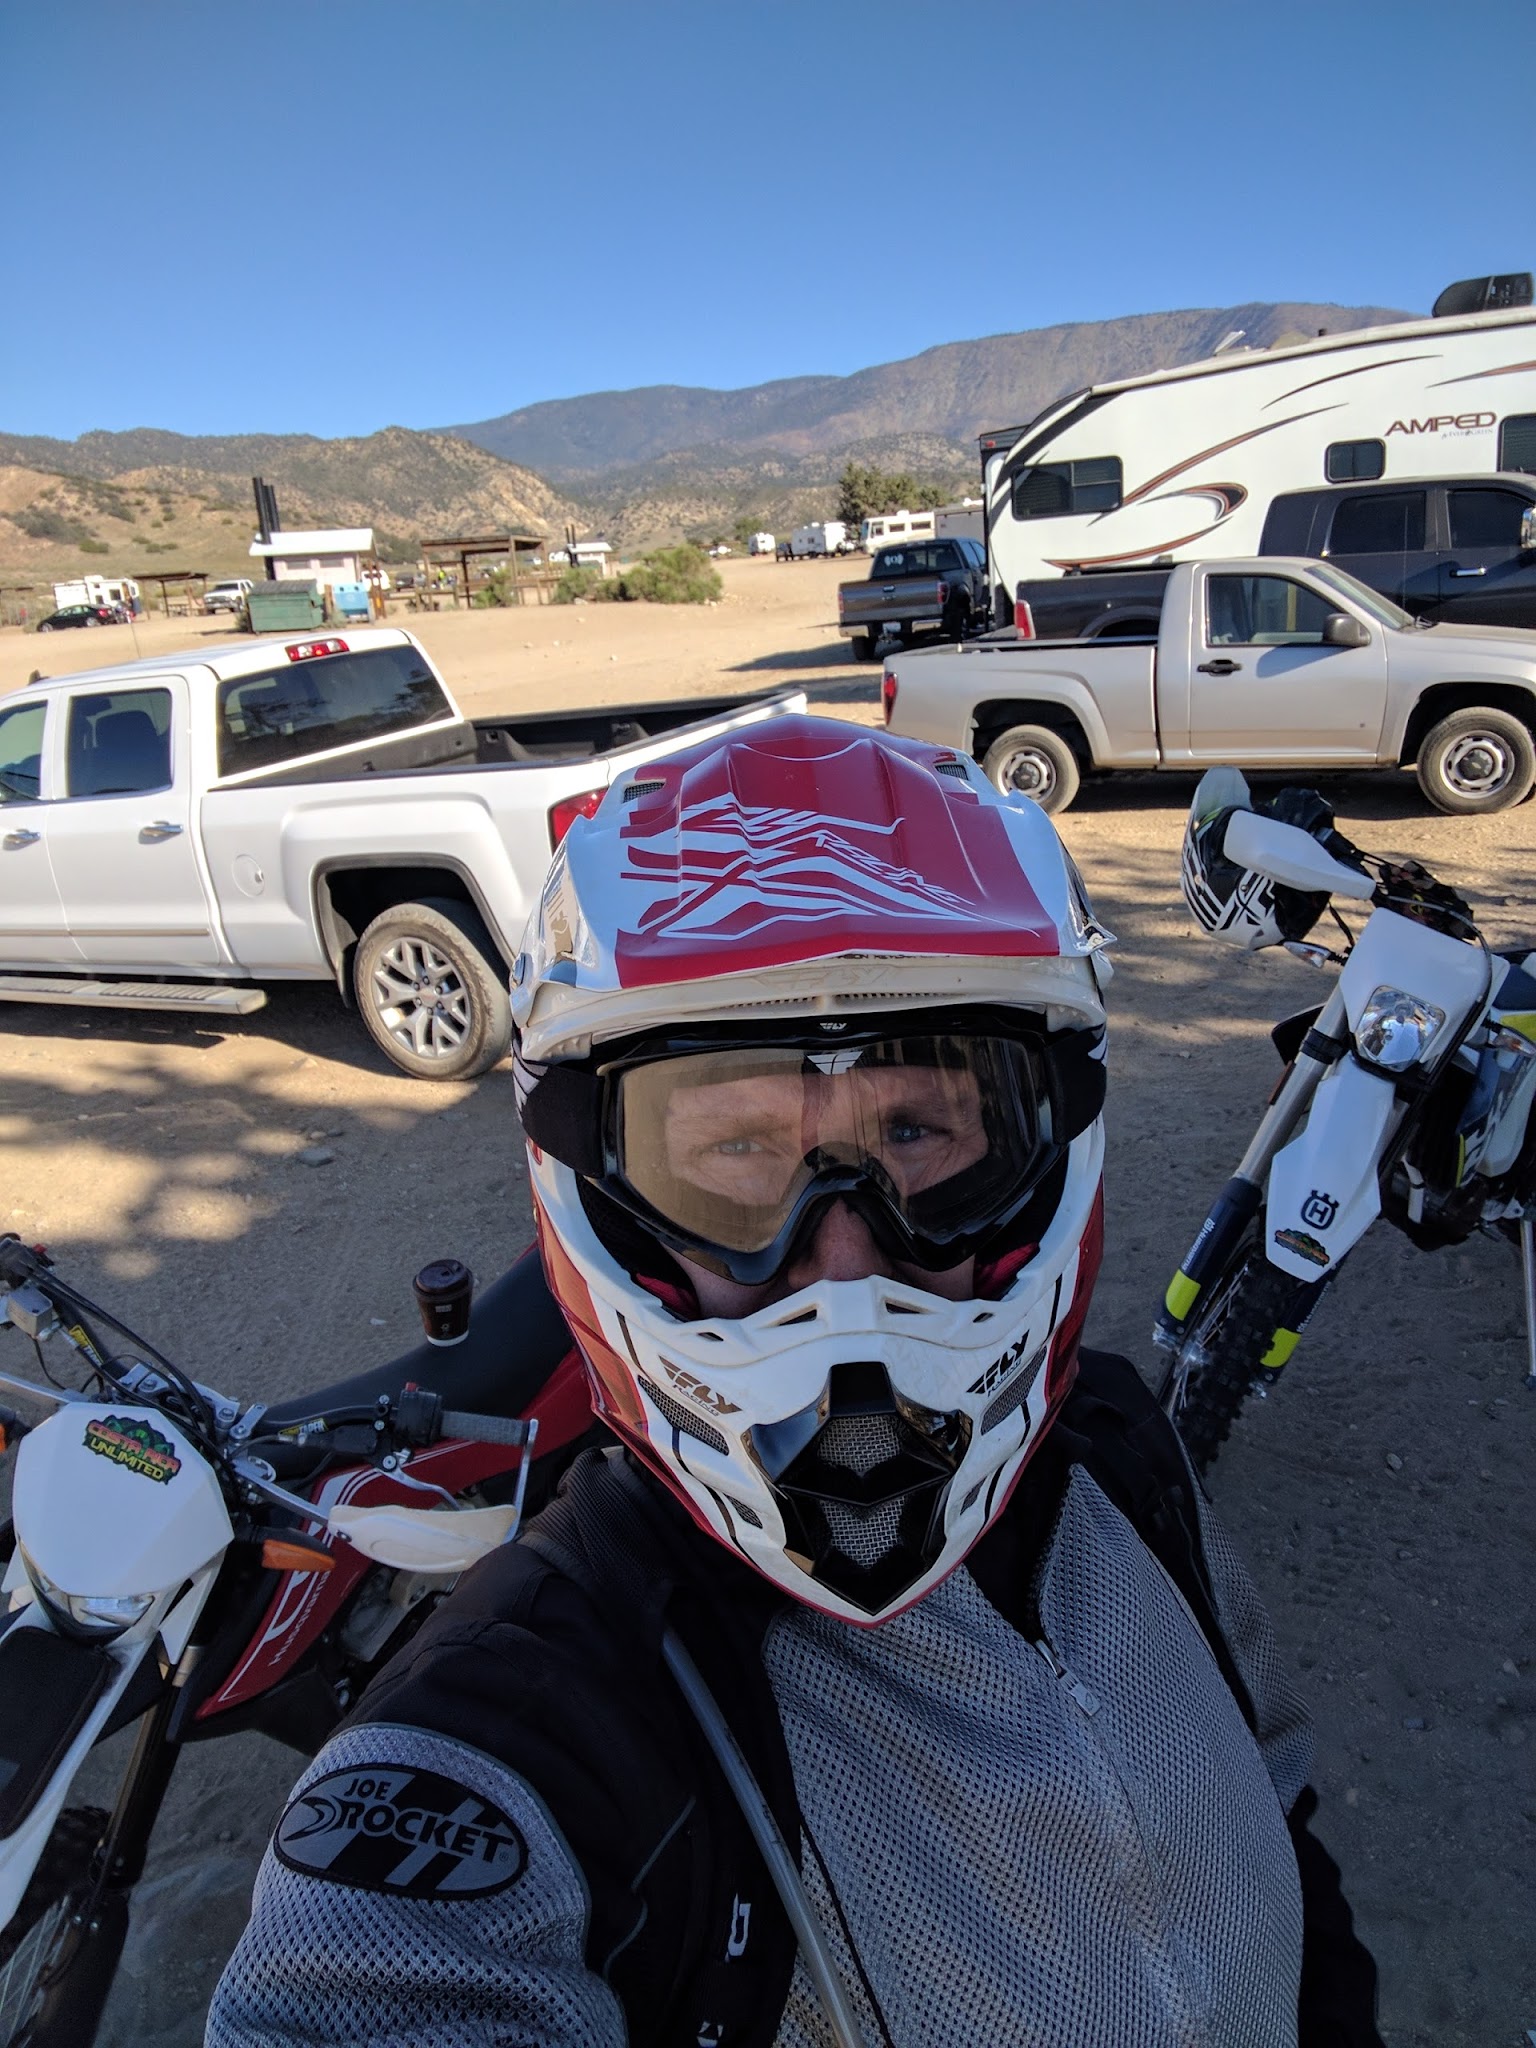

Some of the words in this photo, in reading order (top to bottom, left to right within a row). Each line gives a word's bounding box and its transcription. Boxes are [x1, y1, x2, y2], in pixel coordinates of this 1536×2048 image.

[1384, 411, 1497, 437] AMPED
[819, 1022, 848, 1030] FLY
[658, 1354, 743, 1415] FLY
[965, 1328, 1030, 1394] FLY
[90, 1437, 164, 1480] UNLIMITED
[267, 1570, 331, 1667] Husqvarna
[344, 1778, 392, 1800] JOE
[335, 1800, 514, 1863] ROCKET
